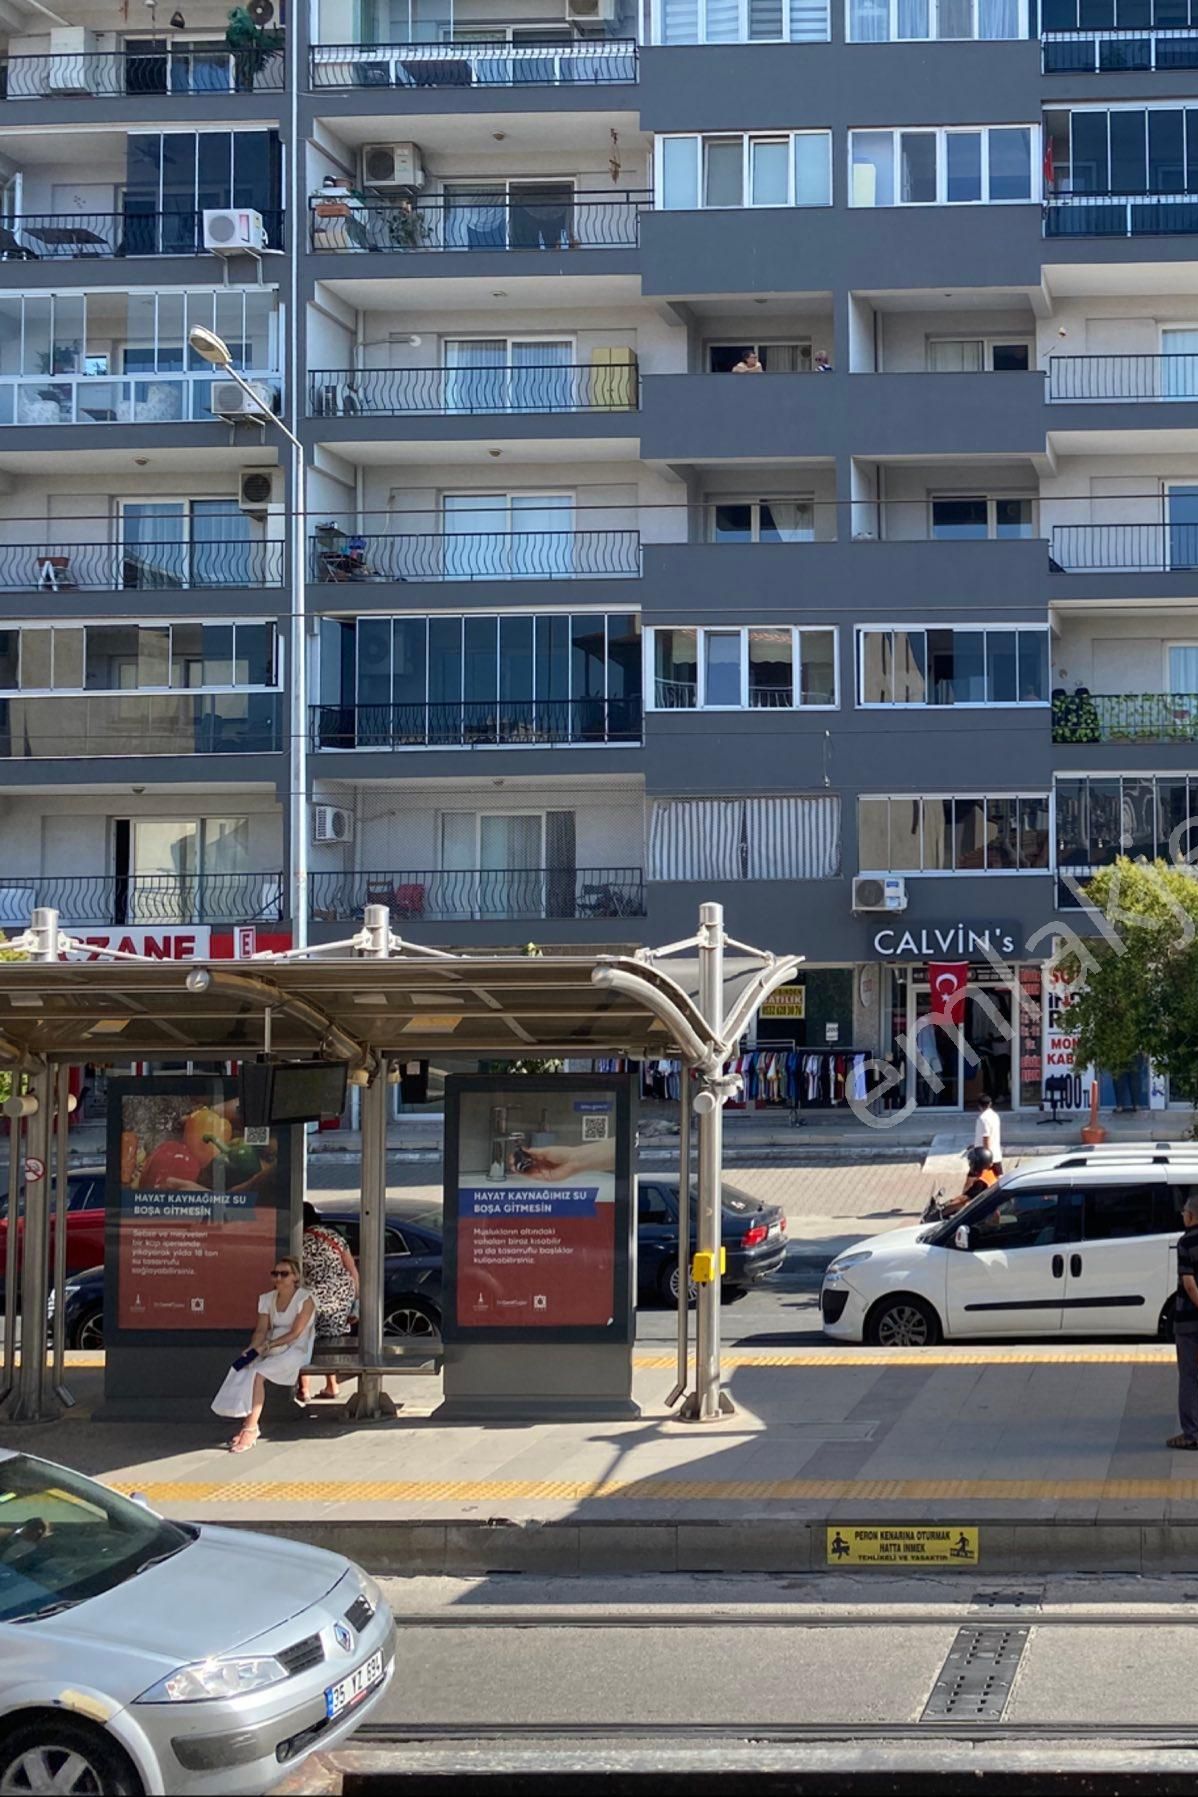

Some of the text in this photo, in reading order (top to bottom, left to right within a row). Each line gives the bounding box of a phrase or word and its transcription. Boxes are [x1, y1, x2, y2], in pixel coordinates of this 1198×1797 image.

[874, 923, 1014, 955] CALVİN's
[58, 935, 195, 960] CZANE
[1051, 1039, 1080, 1049] MON
[1047, 1054, 1077, 1065] KAB
[134, 1194, 246, 1204] HAYAT KAYNAĞIMIZ SU
[474, 1190, 587, 1200] HAYAT KAYNAĞIMIZ SU
[134, 1206, 211, 1216] BOŞA GİTMESİN
[474, 1202, 552, 1214] BOŞA GİTMESİN
[854, 1531, 950, 1540] PERON KENARINA OTURMAK
[880, 1543, 900, 1552] HATTA
[334, 1684, 345, 1708] 35
[352, 1670, 362, 1694] YZ
